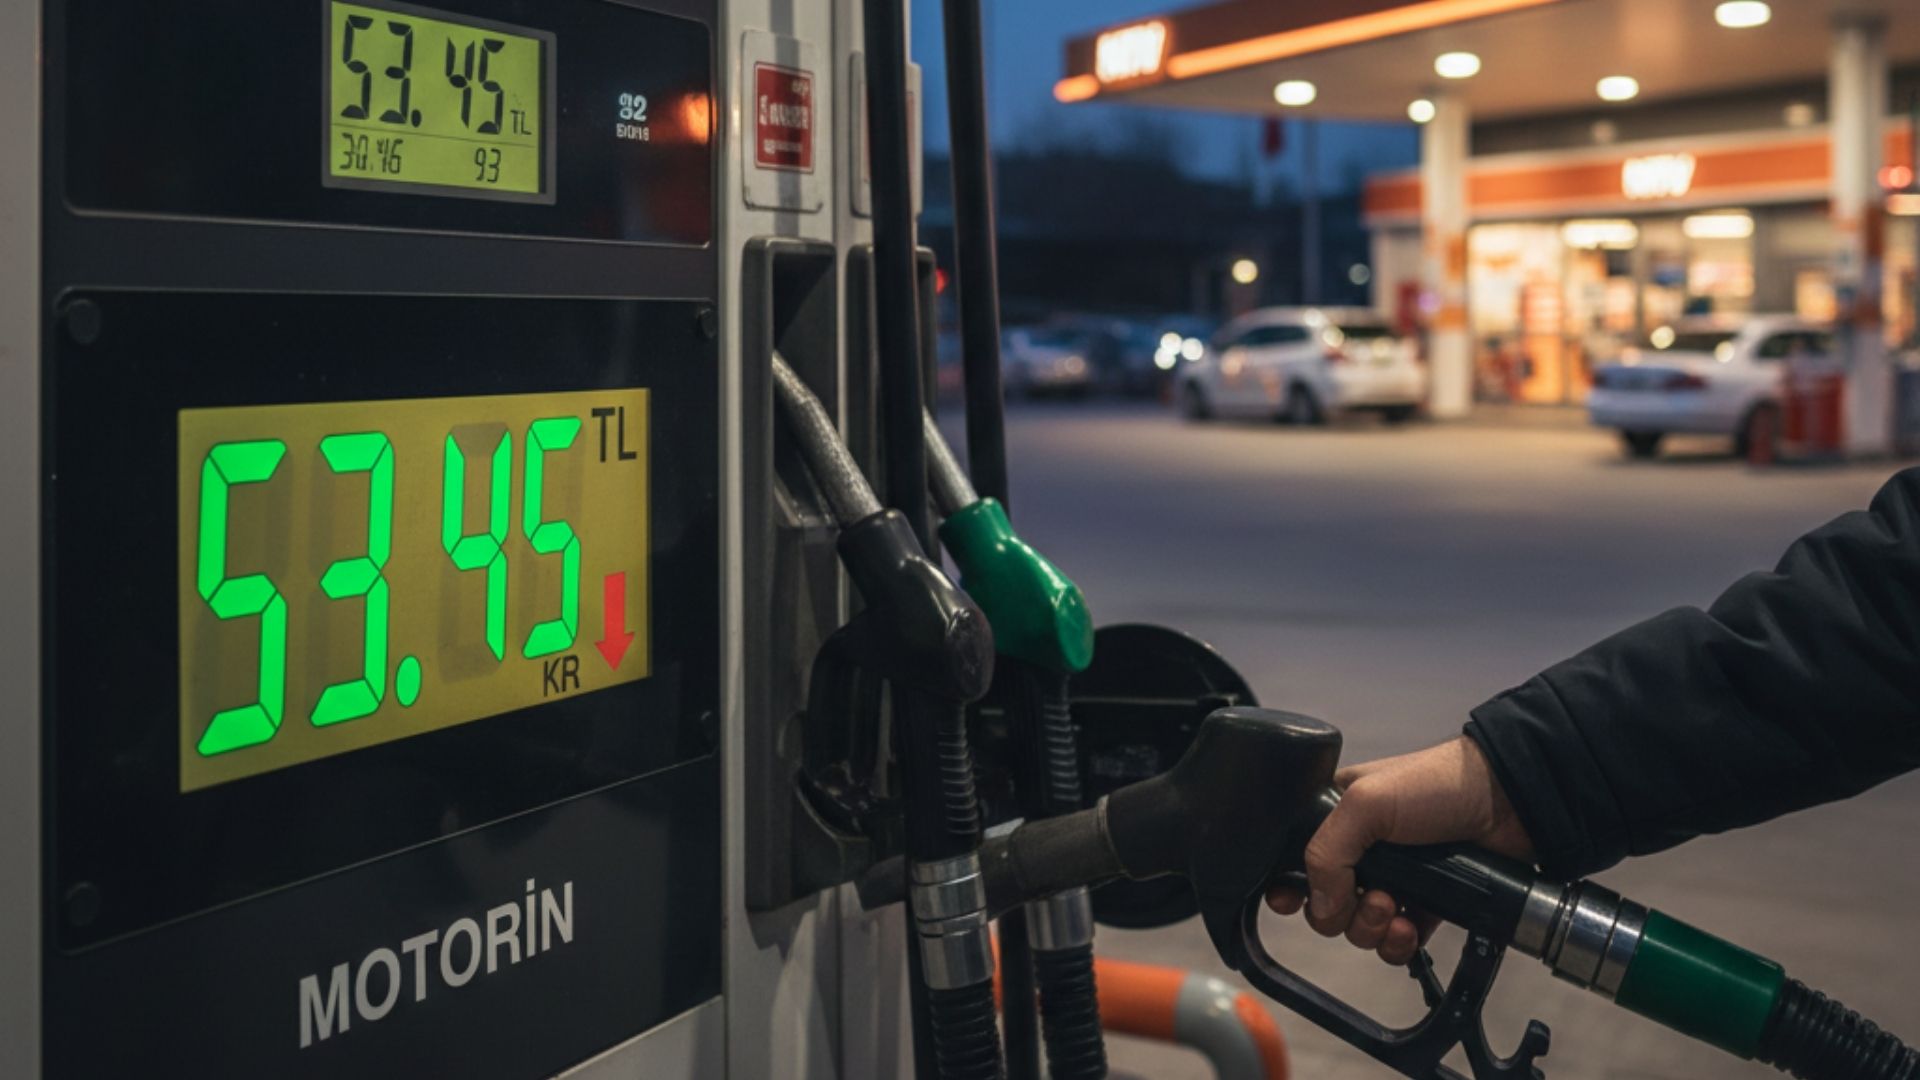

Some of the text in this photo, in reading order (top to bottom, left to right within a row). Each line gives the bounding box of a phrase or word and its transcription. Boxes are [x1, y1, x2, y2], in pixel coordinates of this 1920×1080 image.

[340, 14, 532, 136] 53.45 TL
[474, 147, 501, 183] 93
[196, 406, 637, 758] 53.45 TL
[543, 655, 581, 697] KR
[299, 878, 574, 1049] MOTORİN
